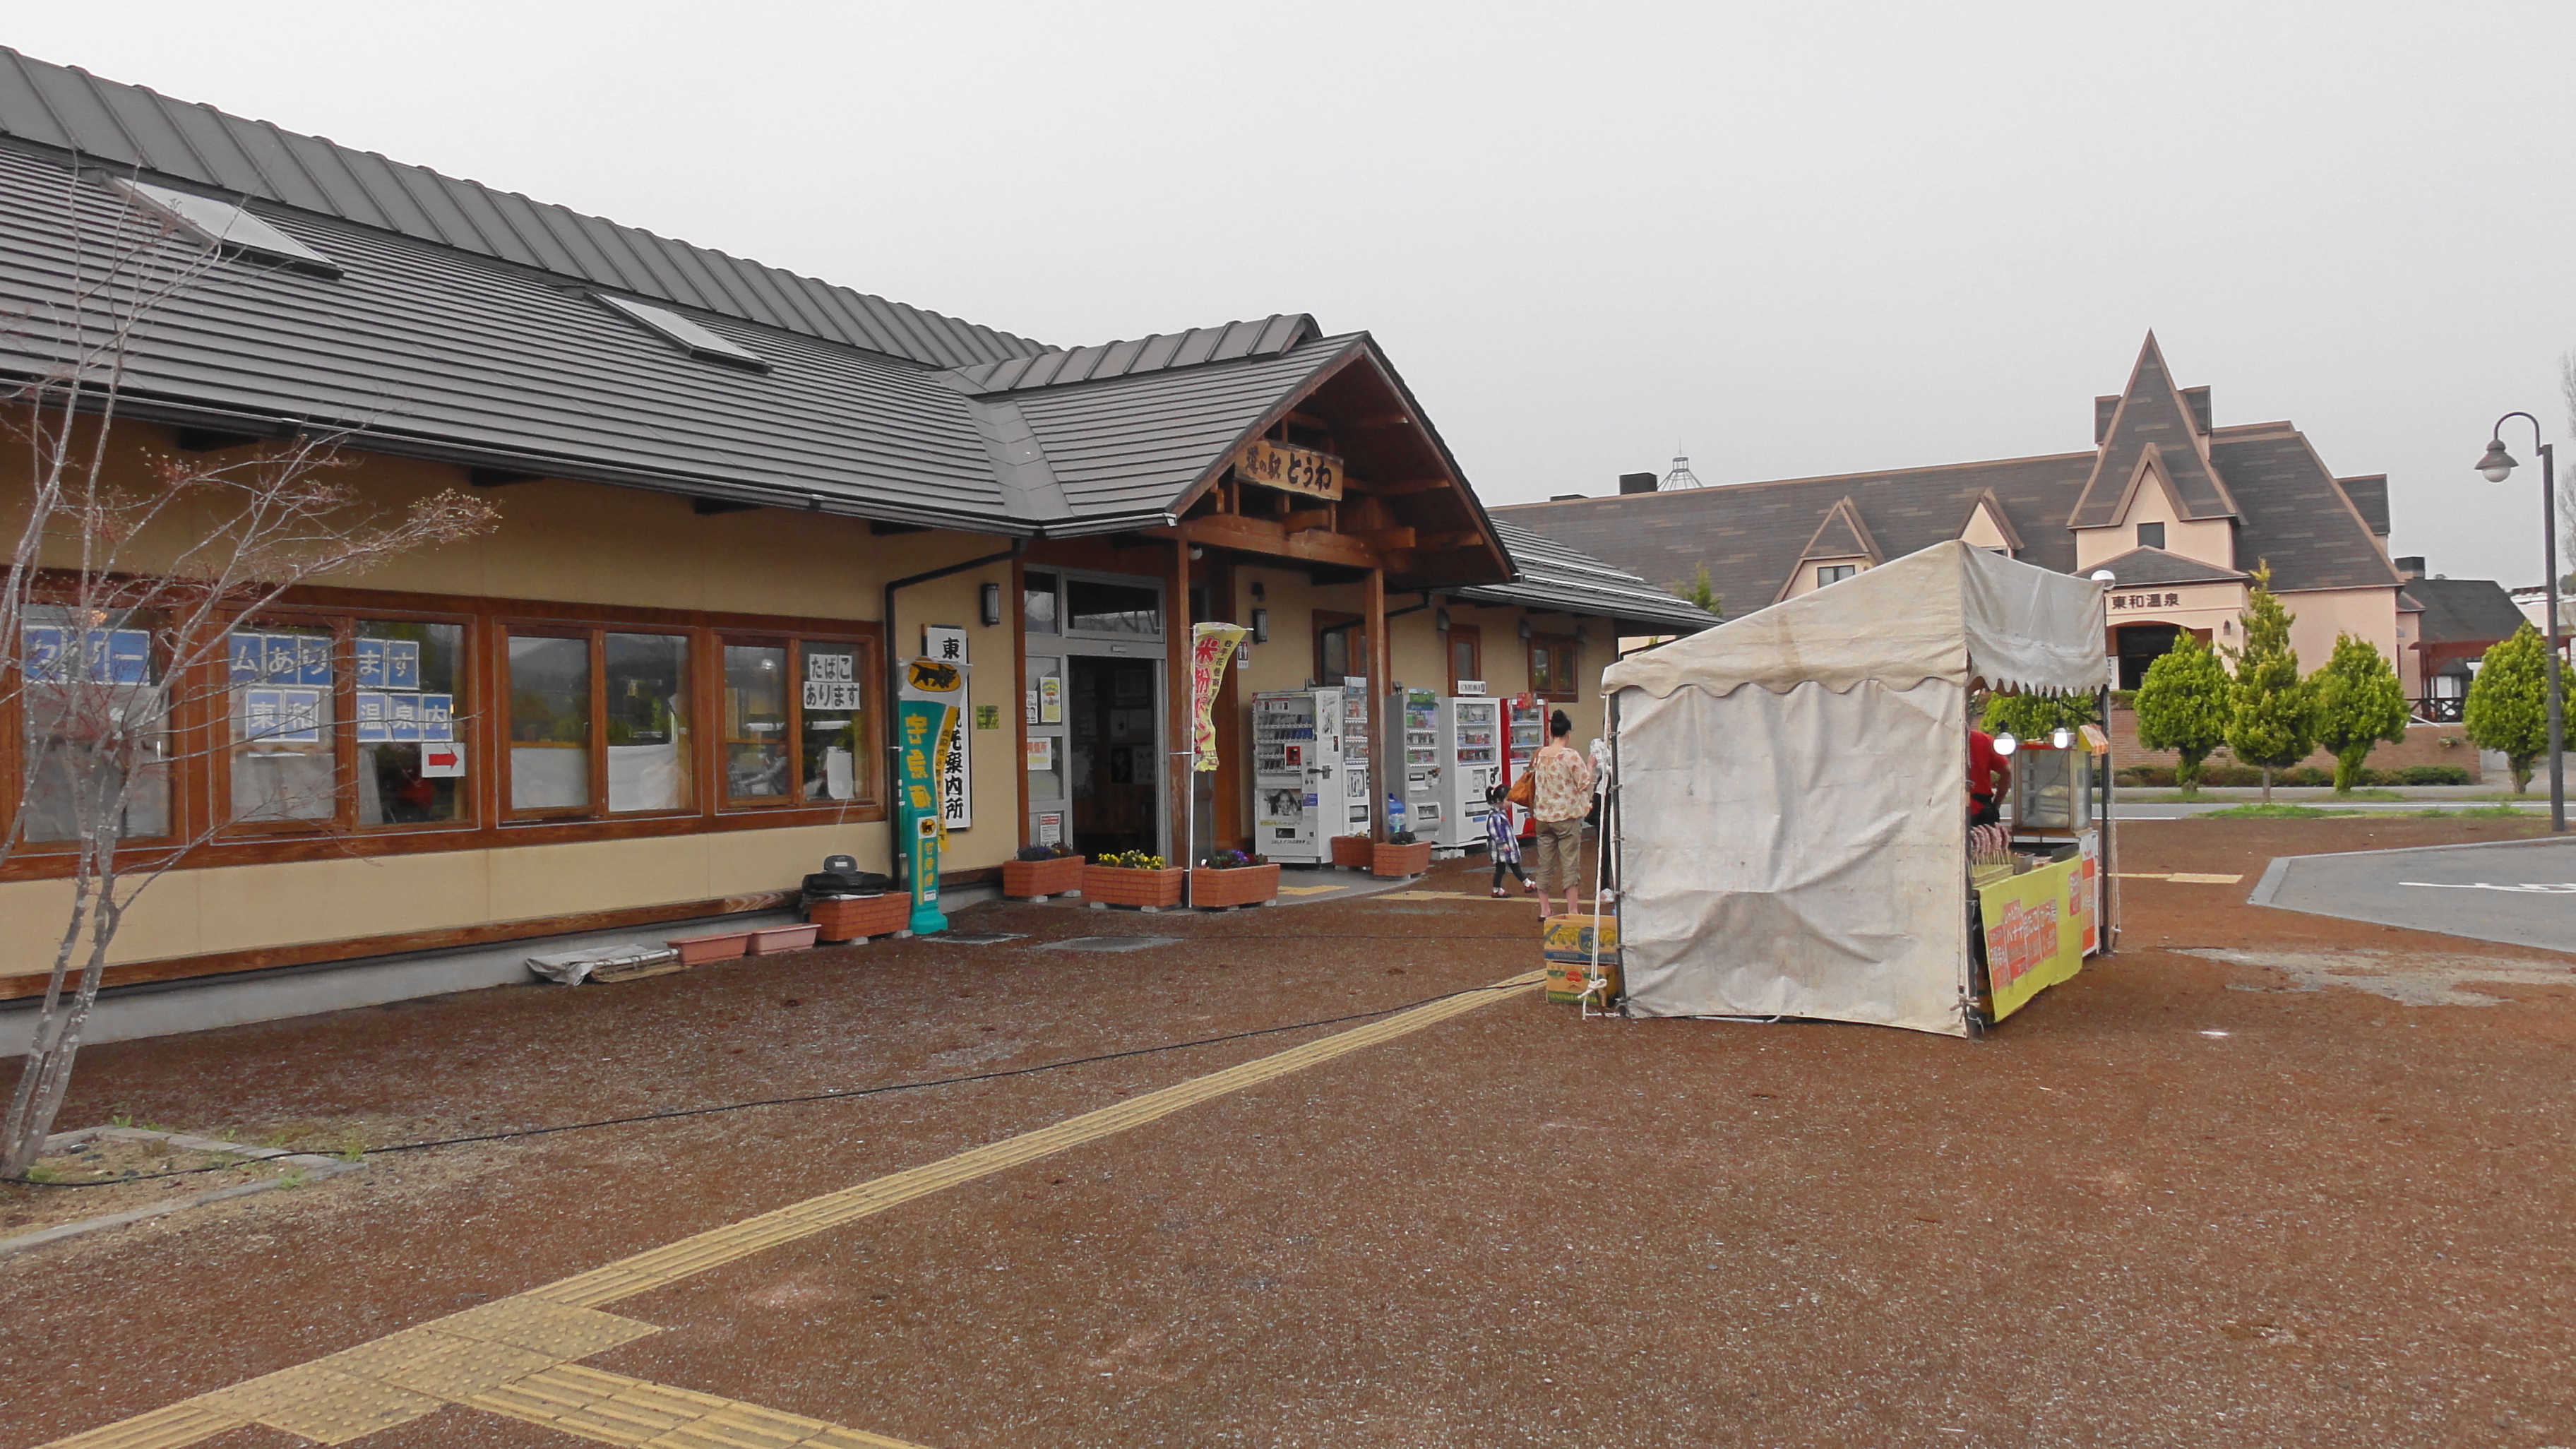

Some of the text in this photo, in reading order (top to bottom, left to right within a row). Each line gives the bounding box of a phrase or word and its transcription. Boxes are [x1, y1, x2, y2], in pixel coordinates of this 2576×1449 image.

[2111, 592, 2180, 609] 東和温泉
[811, 656, 850, 679] たばこ
[806, 684, 859, 707] あります
